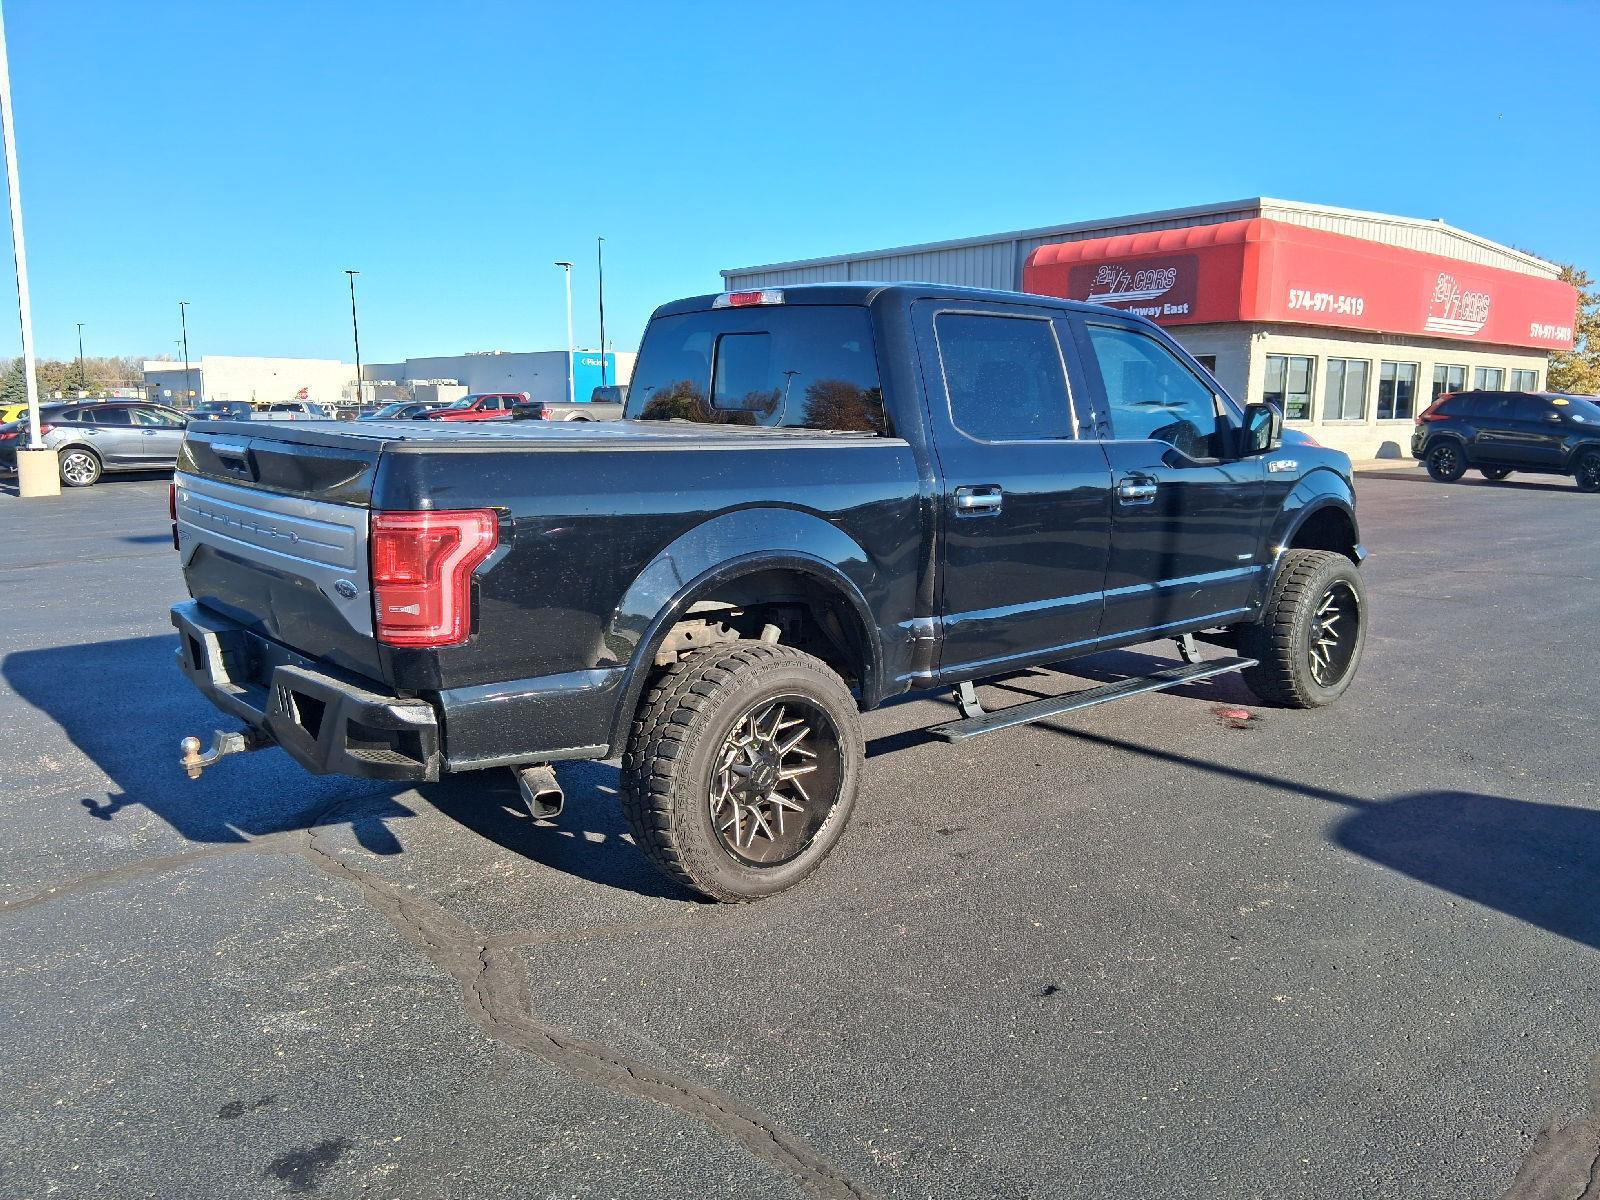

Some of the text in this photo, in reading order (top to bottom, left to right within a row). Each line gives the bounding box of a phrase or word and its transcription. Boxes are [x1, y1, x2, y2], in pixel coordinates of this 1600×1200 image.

[1097, 265, 1176, 293] 24/7 CARS
[1163, 303, 1189, 315] East
[1288, 288, 1364, 316] 574-971-5419
[1460, 291, 1490, 322] CARS
